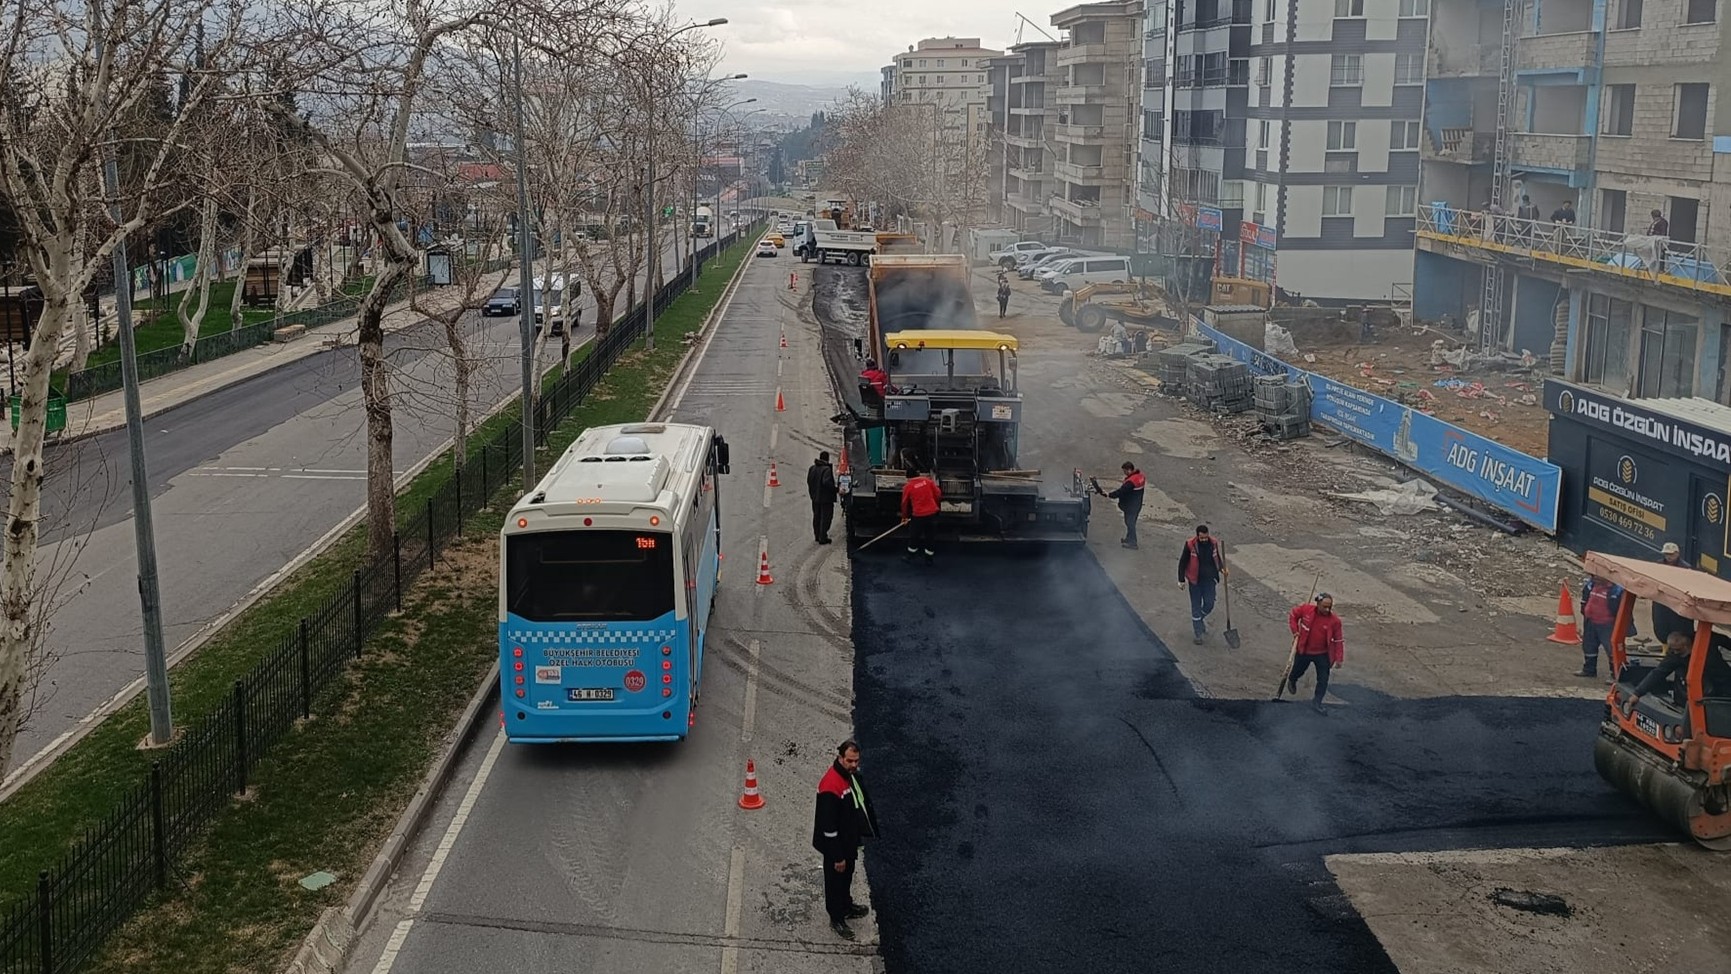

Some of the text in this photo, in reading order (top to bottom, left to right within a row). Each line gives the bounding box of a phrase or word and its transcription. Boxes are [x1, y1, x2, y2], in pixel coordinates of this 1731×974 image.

[1217, 283, 1230, 292] CAT
[1612, 407, 1669, 443] ÖZGÜN
[1673, 425, 1731, 464] İNŞAA
[1447, 442, 1536, 498] ADG İNŞAAT
[1609, 482, 1635, 500] ÖZGÜN
[1635, 492, 1665, 512] İNŞAAT
[1609, 497, 1645, 519] SATIŞ OFİSİ
[1600, 507, 1655, 540] 0530 469 72 36
[543, 647, 640, 659] BÜYÜKŞEHİR BELEDİYESİ
[549, 658, 635, 667] ÖZEL HALK OTOBÜSÜ
[625, 676, 644, 687] 0329
[573, 689, 582, 698] 46
[594, 689, 611, 698] 0329
